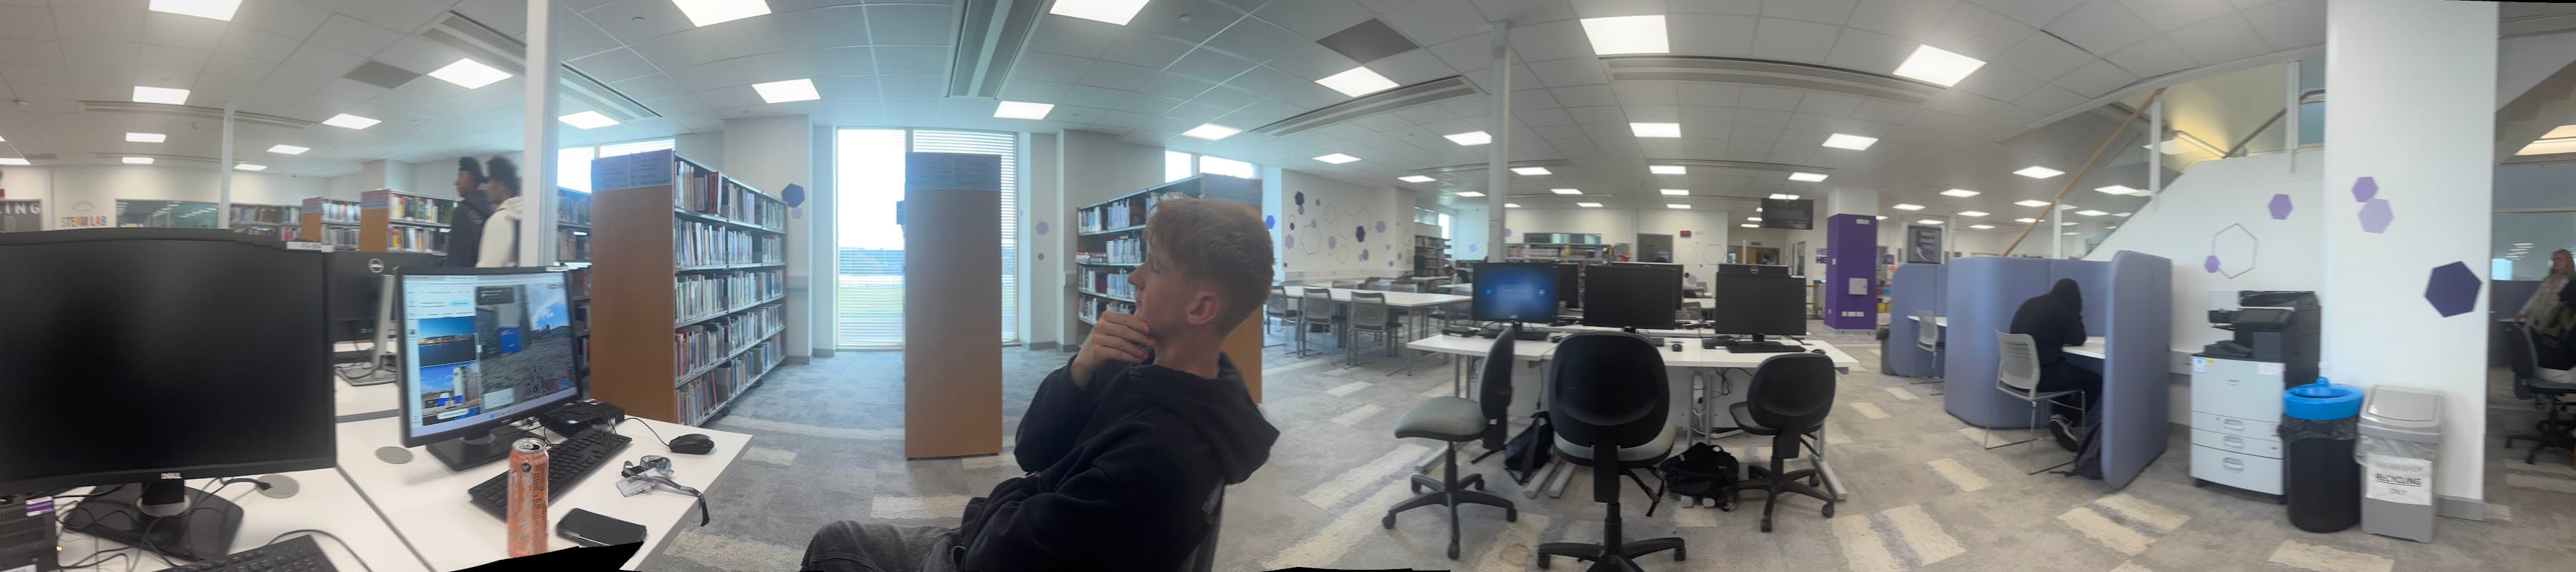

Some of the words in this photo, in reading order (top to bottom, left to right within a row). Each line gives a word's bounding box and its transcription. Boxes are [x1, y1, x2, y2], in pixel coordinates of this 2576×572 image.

[0, 202, 41, 214] ING
[61, 217, 89, 227] STEAM
[91, 216, 106, 226] LAB
